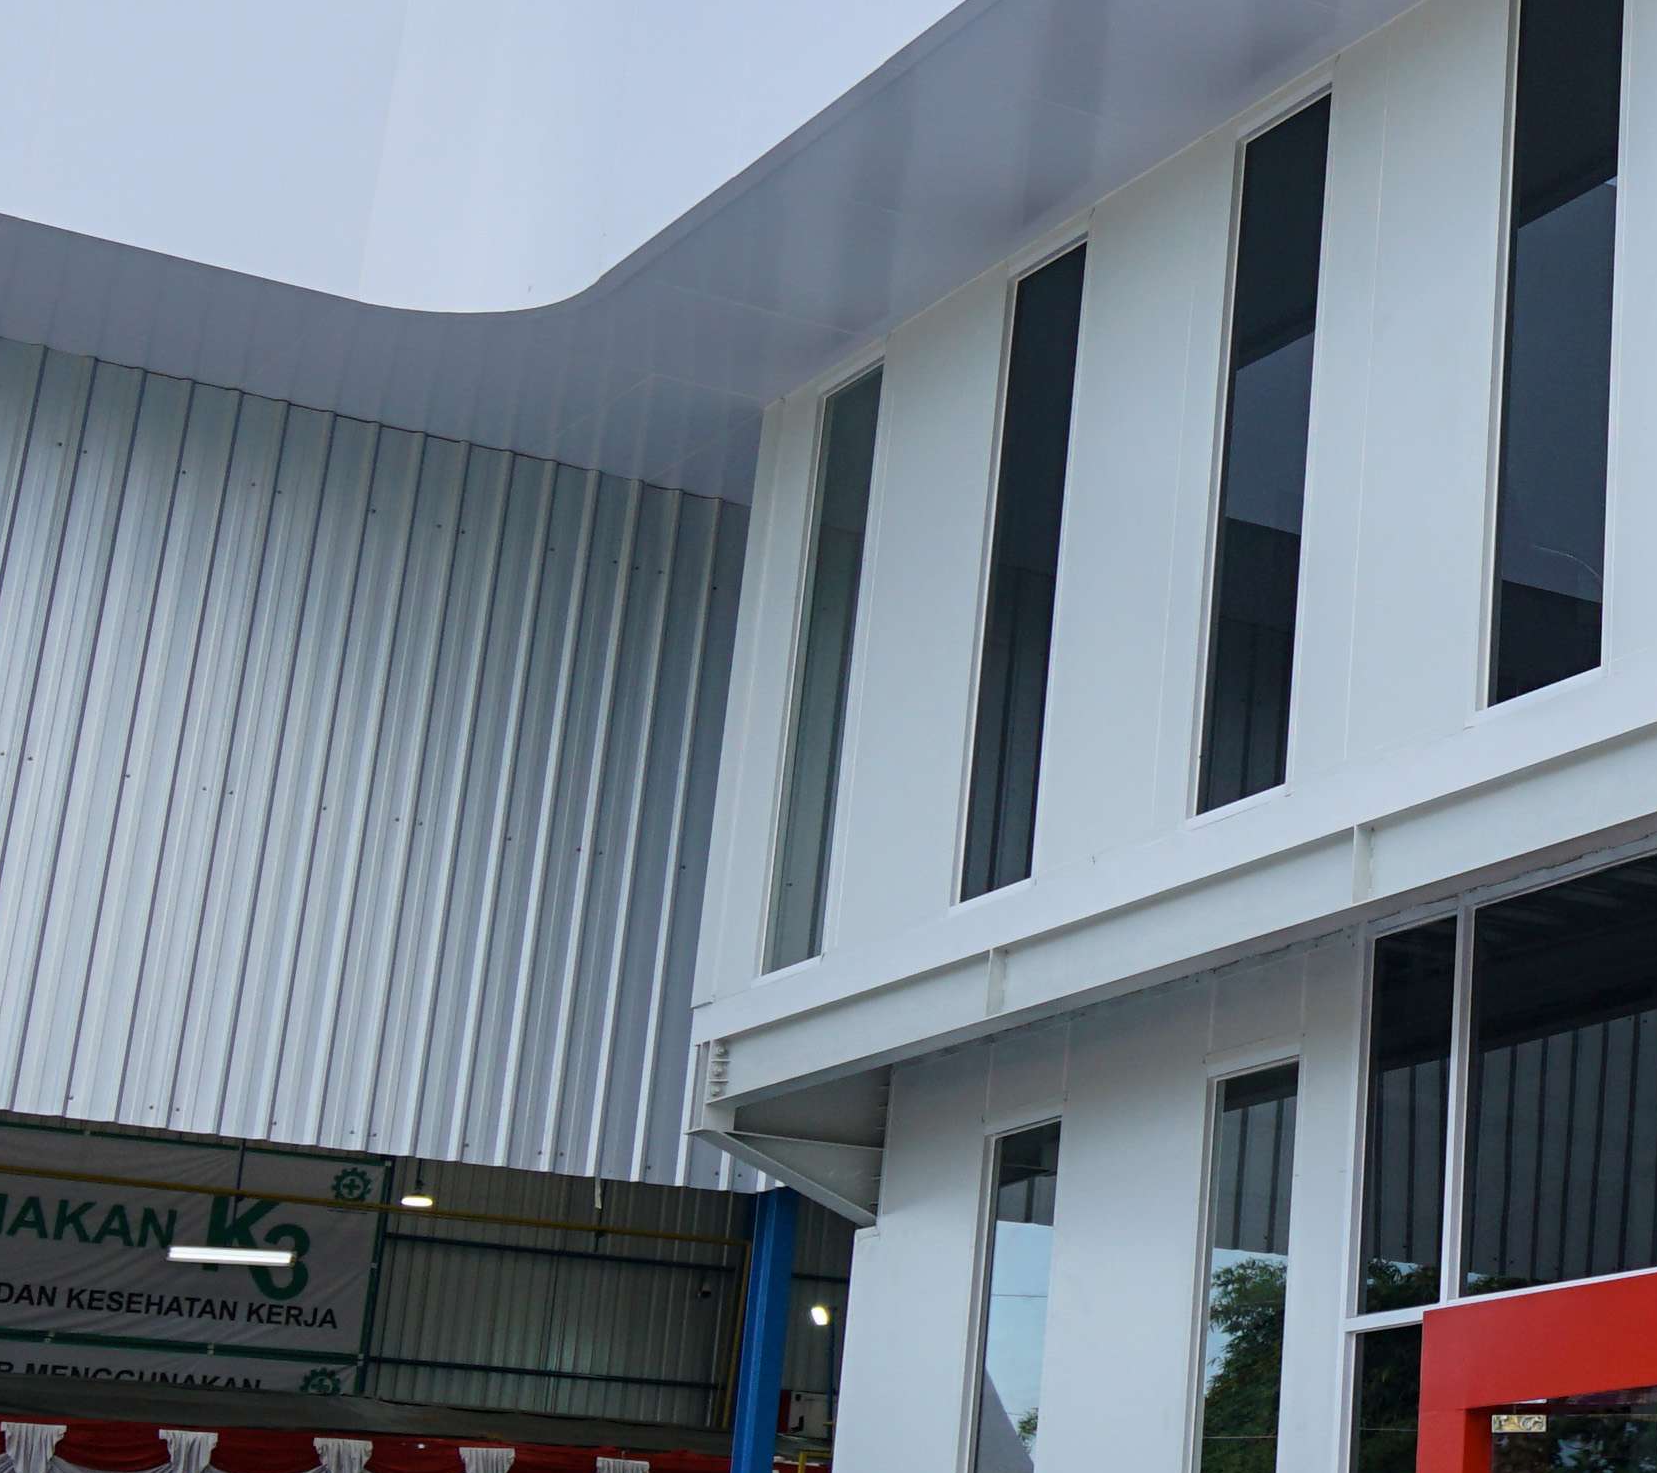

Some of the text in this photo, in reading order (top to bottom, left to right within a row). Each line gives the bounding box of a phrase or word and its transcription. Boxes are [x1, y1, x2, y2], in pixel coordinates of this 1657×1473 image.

[202, 1195, 310, 1301] K3
[66, 1286, 237, 1323] KESEHATAN
[244, 1301, 339, 1330] KERJA
